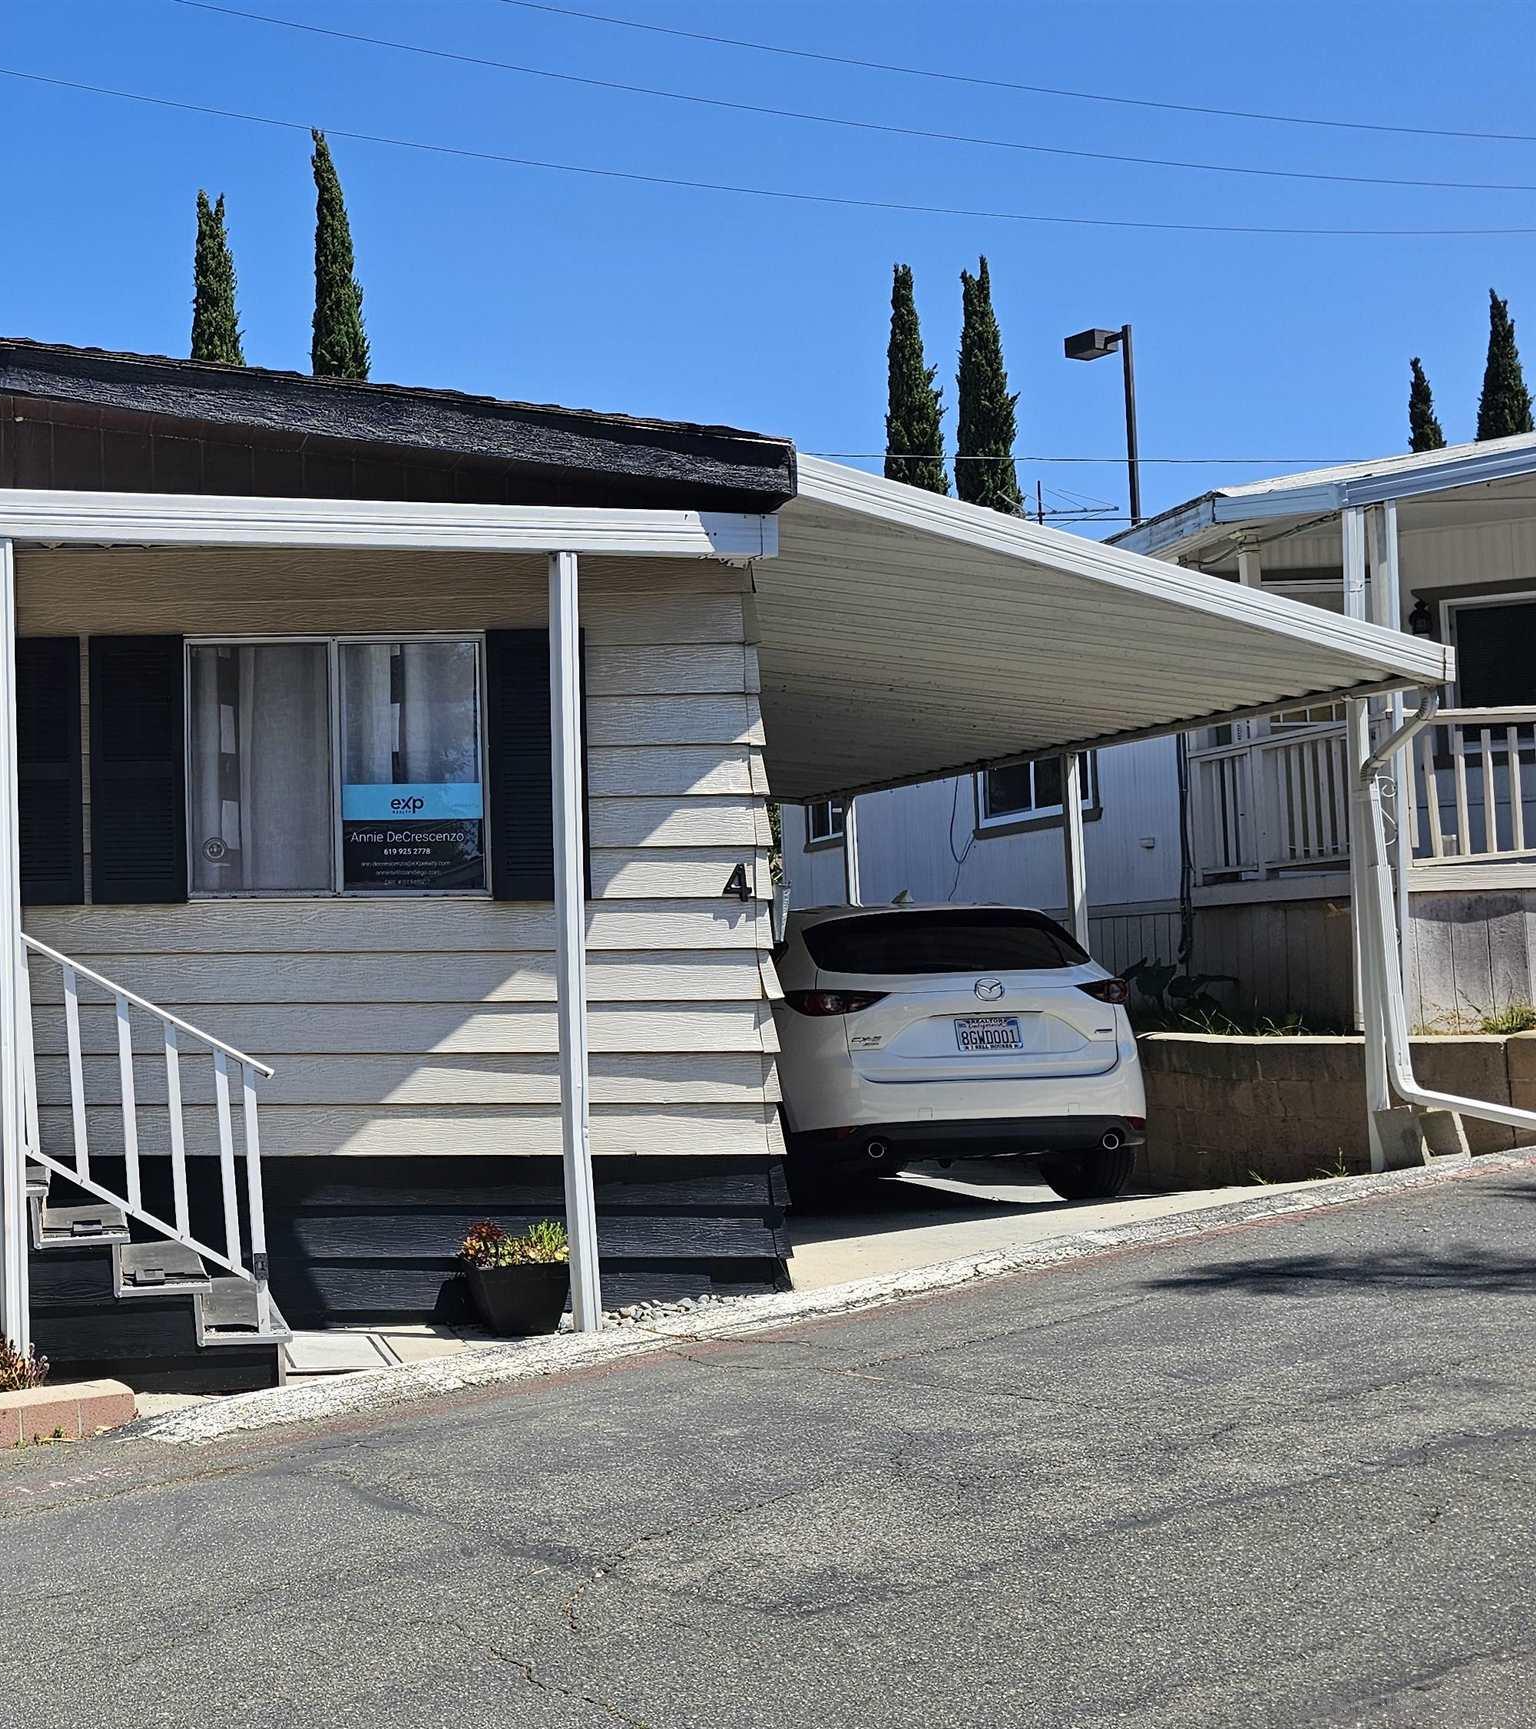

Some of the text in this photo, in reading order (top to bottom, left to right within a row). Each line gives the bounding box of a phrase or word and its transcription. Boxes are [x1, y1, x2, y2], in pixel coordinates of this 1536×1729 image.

[350, 832, 464, 843] Annie DeCrescenzo
[723, 863, 753, 902] 4
[961, 1029, 1017, 1046] 8GWD001
